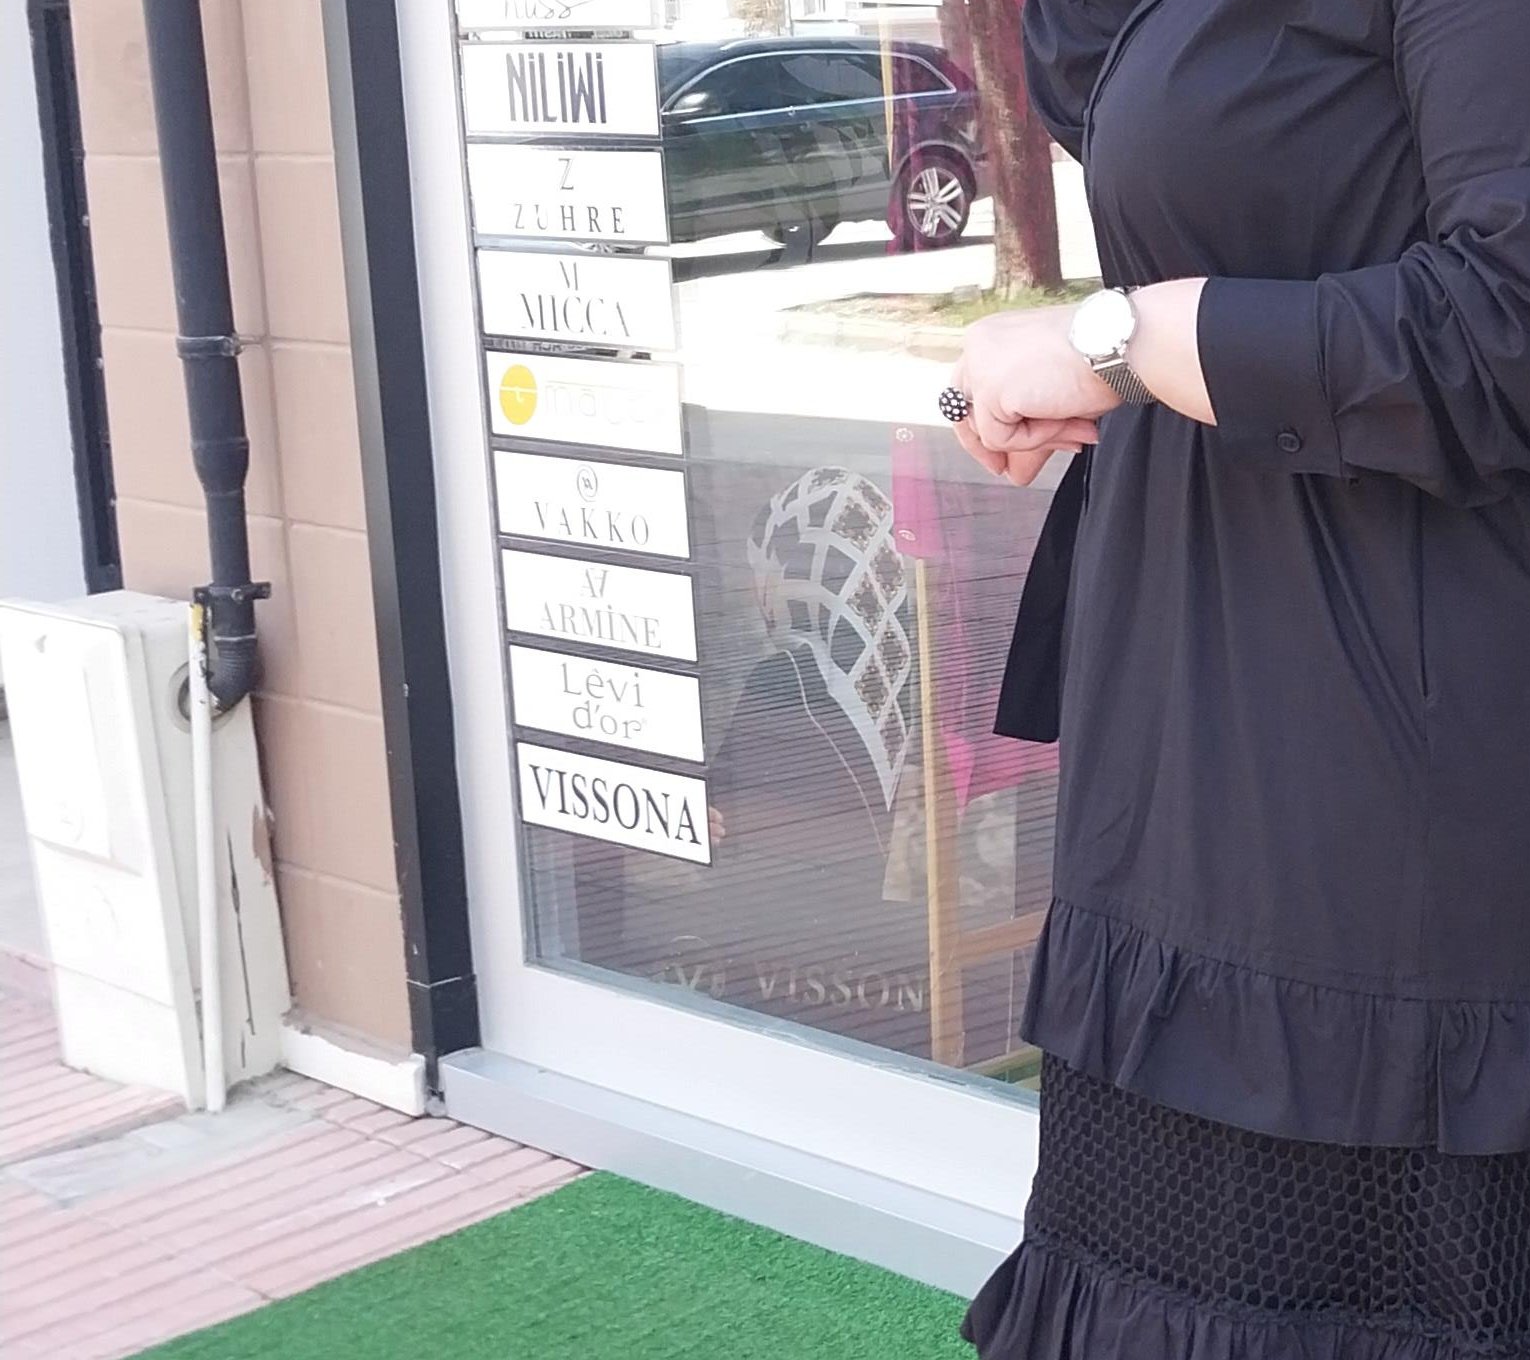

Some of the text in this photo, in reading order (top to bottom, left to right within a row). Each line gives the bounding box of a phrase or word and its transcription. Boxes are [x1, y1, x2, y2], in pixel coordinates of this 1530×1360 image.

[534, 501, 650, 546] VAKKO
[539, 601, 662, 649] ARMİNE
[529, 764, 702, 845] VISSONA
